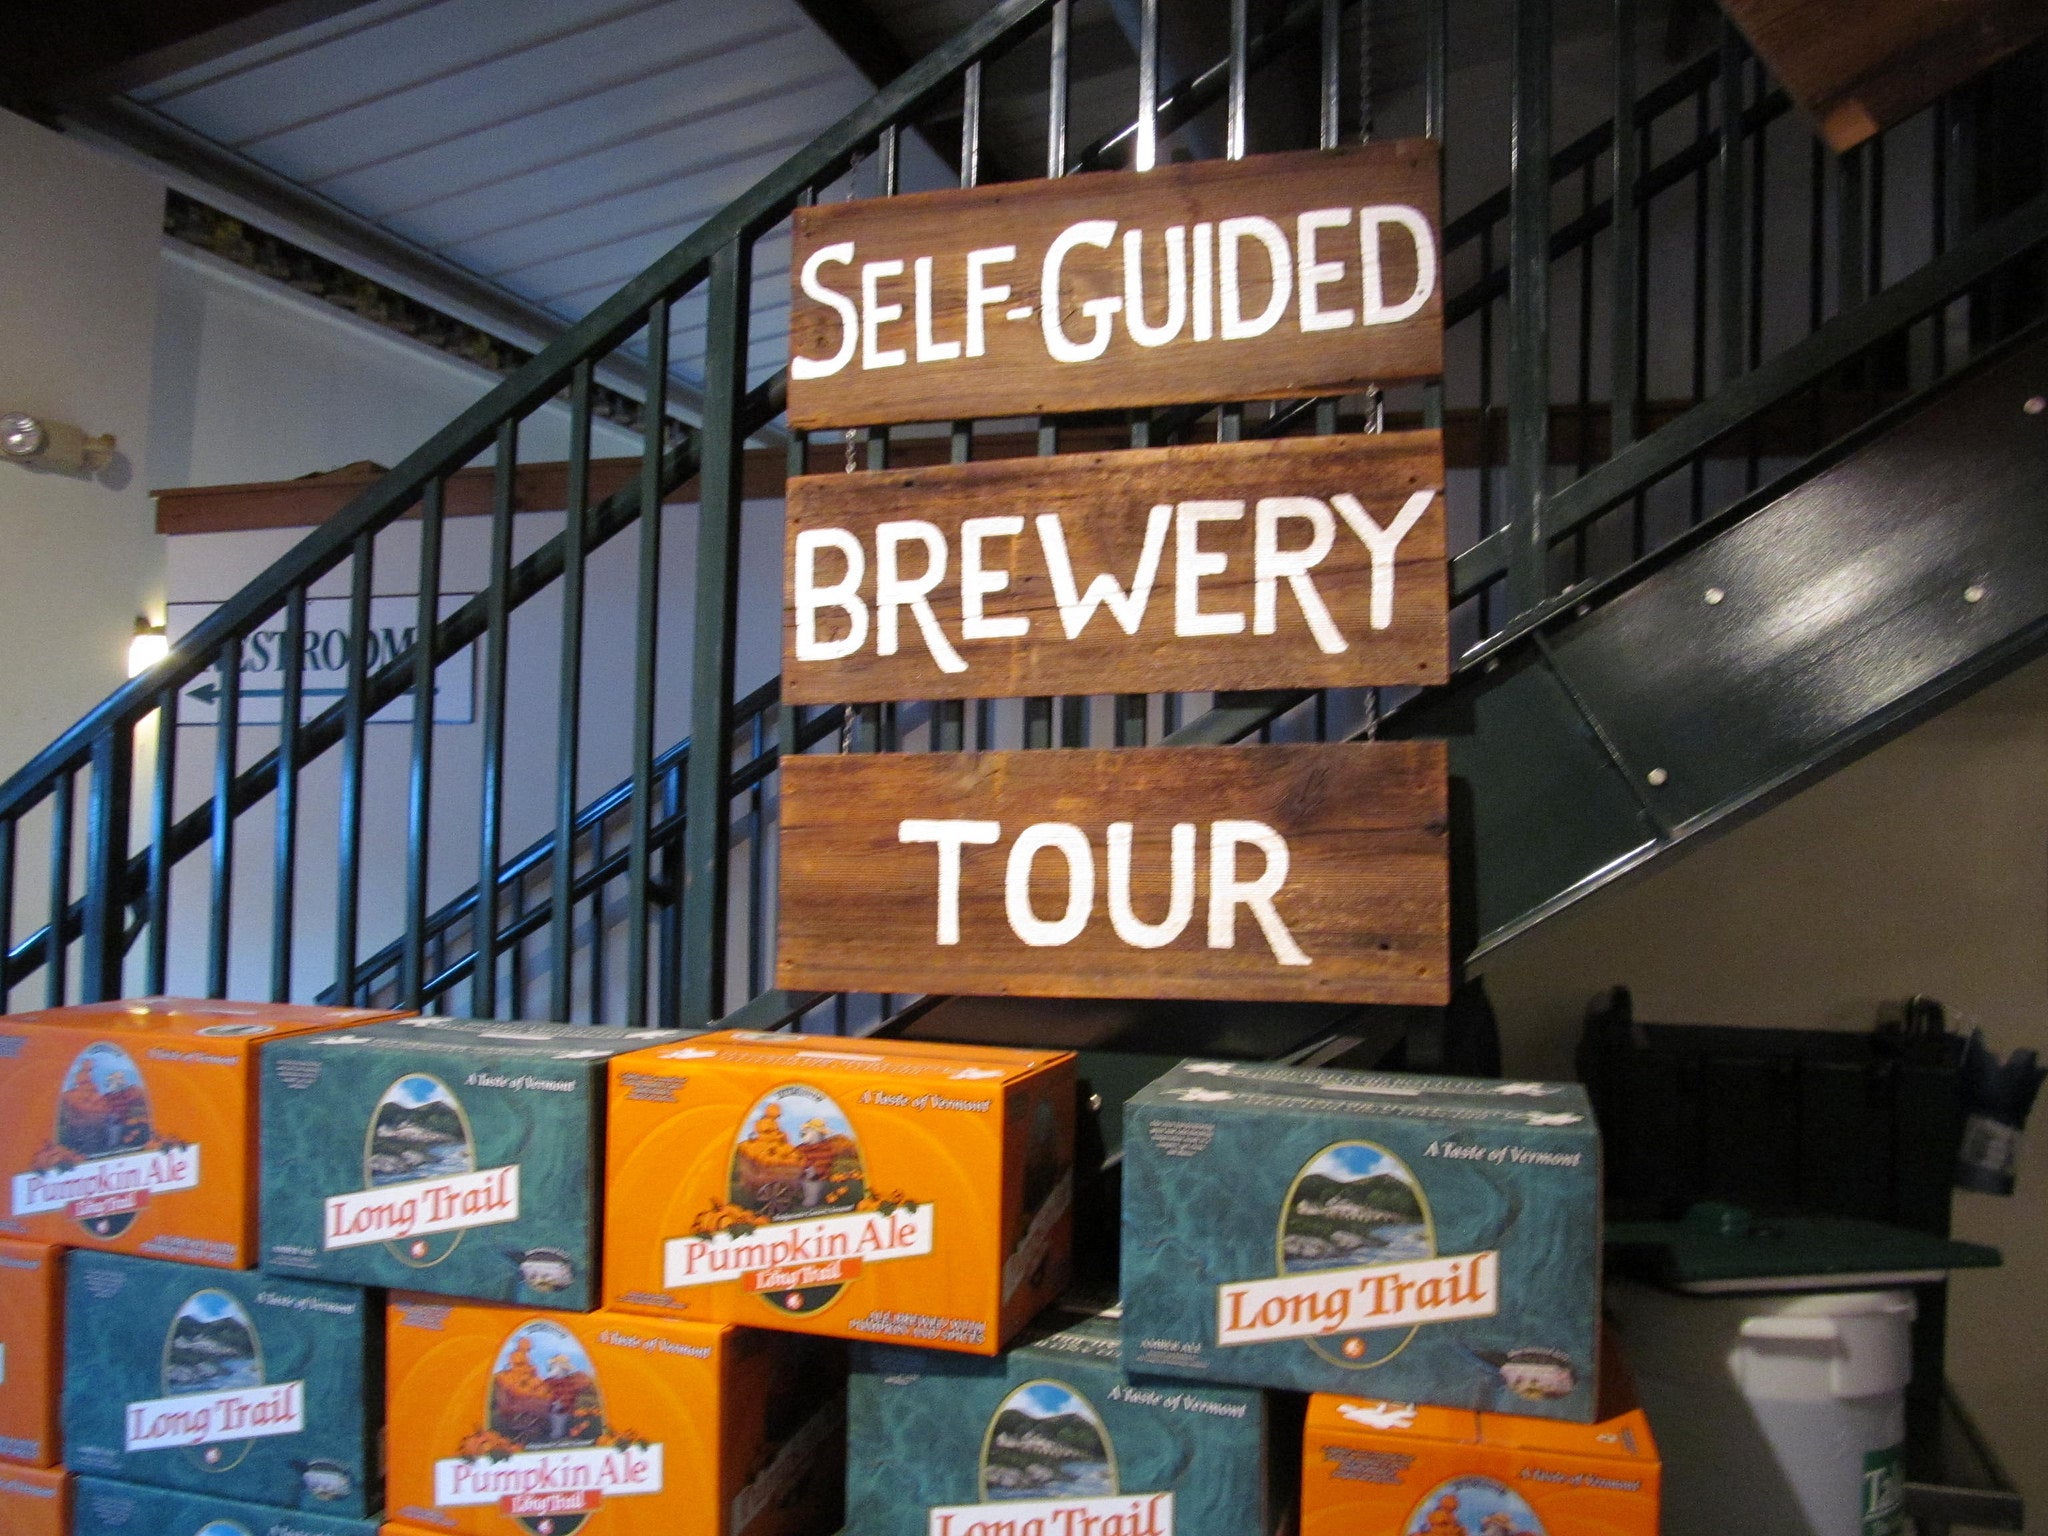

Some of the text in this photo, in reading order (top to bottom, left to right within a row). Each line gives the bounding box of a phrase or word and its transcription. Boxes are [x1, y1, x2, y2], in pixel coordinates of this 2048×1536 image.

[792, 205, 1437, 380] SELF-GUIDED
[794, 490, 1437, 673] BREWERY
[897, 819, 1313, 967] TOUR
[147, 1153, 188, 1185] Ale
[1423, 1140, 1583, 1167] A Taste of Vermont
[330, 1166, 513, 1238] Long Trail
[684, 1215, 918, 1277] Pumpkin Ale
[1225, 1252, 1491, 1334] Long Trail
[130, 1381, 297, 1444] Long Trail
[451, 1451, 649, 1495] Pumpkin Ale
[936, 1493, 1168, 1536] Long Trail
